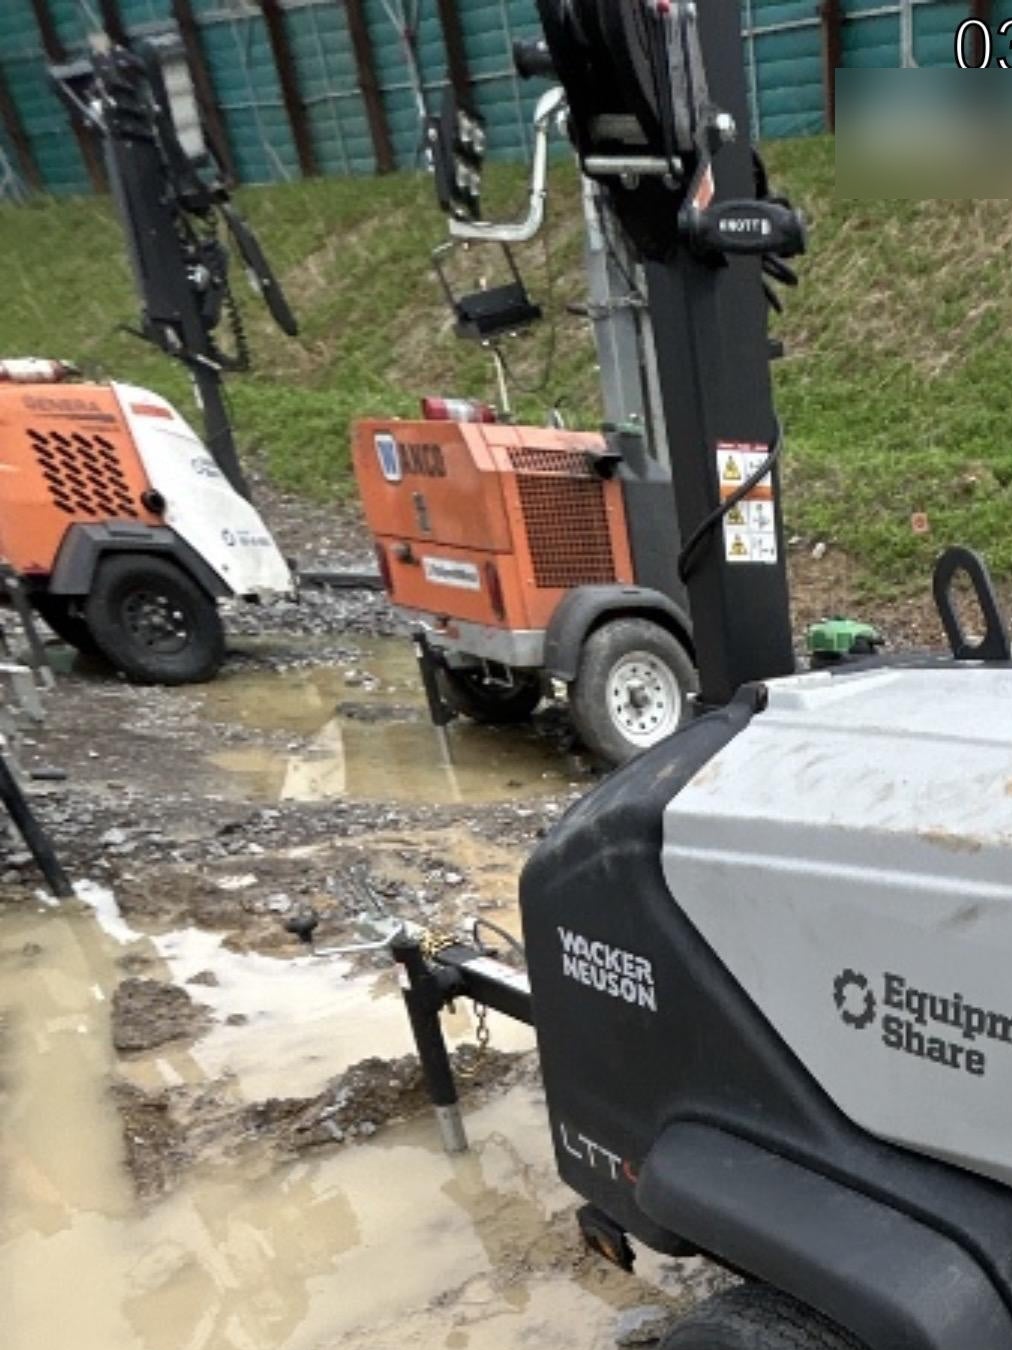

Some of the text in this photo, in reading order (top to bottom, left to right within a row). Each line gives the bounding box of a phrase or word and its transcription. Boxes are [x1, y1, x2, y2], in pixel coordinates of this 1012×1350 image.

[719, 218, 760, 232] KNOTT
[557, 925, 655, 985] WACKER
[562, 952, 658, 1012] NEUSON
[880, 1013, 986, 1077] Share
